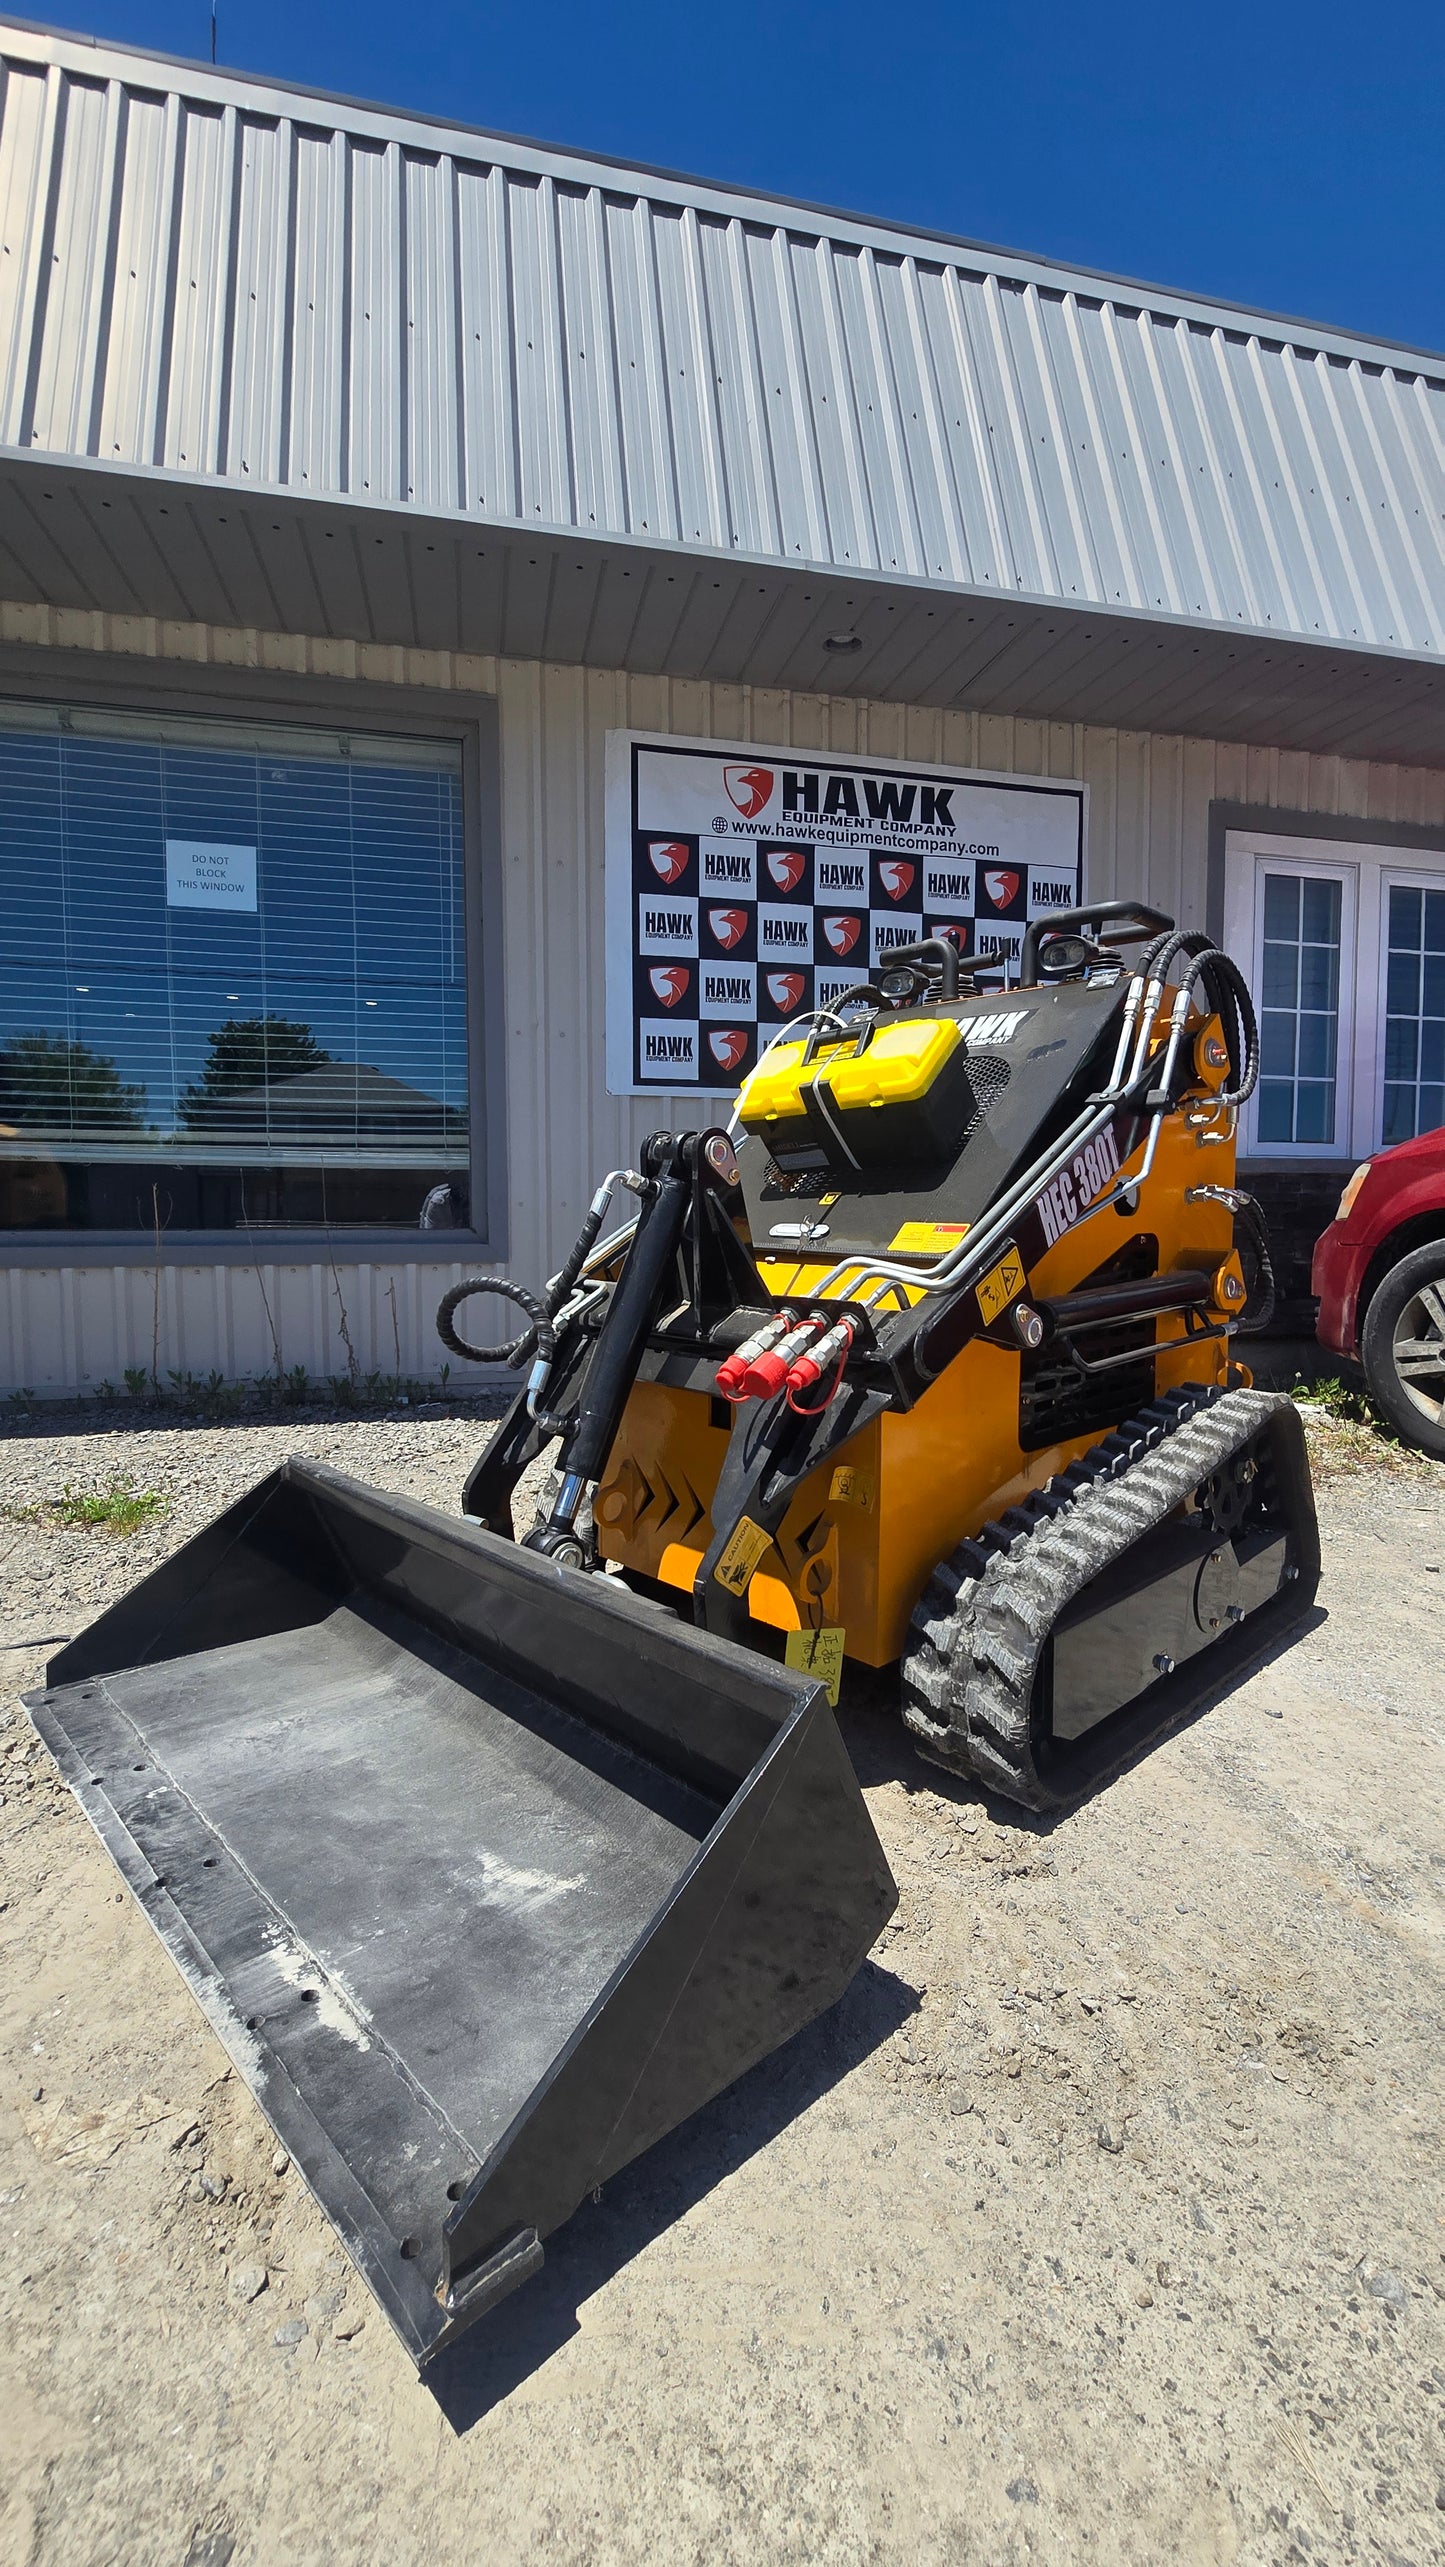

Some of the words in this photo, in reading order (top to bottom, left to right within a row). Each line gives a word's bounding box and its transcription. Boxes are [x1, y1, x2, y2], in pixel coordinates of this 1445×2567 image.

[781, 771, 956, 827] HAWK
[782, 811, 875, 829] EQUIPMENT
[880, 820, 957, 838] COMPANY
[732, 822, 1000, 856] www.hawkequipmentcompany.com
[192, 854, 207, 864] DO
[209, 856, 230, 865] NOT
[705, 853, 751, 878] HAWK
[195, 868, 227, 878] BLOCK
[704, 874, 729, 882] EQUIPMENT
[729, 876, 752, 884] COMPANY
[819, 863, 864, 887] HAWK
[928, 872, 970, 895] HAWK
[177, 880, 198, 889] THIS
[200, 882, 245, 893] WINDOW
[950, 893, 970, 901] COMPANY
[1032, 881, 1071, 903] HAWK
[645, 911, 693, 935] HAWK
[763, 919, 808, 942] HAWK
[671, 933, 693, 941] COMPANY
[705, 976, 751, 999] HAWK
[730, 997, 752, 1005] COMPANY
[646, 1035, 693, 1057] HAWK
[967, 1035, 1012, 1047] COMPANY
[1035, 1172, 1078, 1249] HEC
[1073, 1122, 1119, 1206] 380T
[728, 1523, 749, 1562] CAUTION
